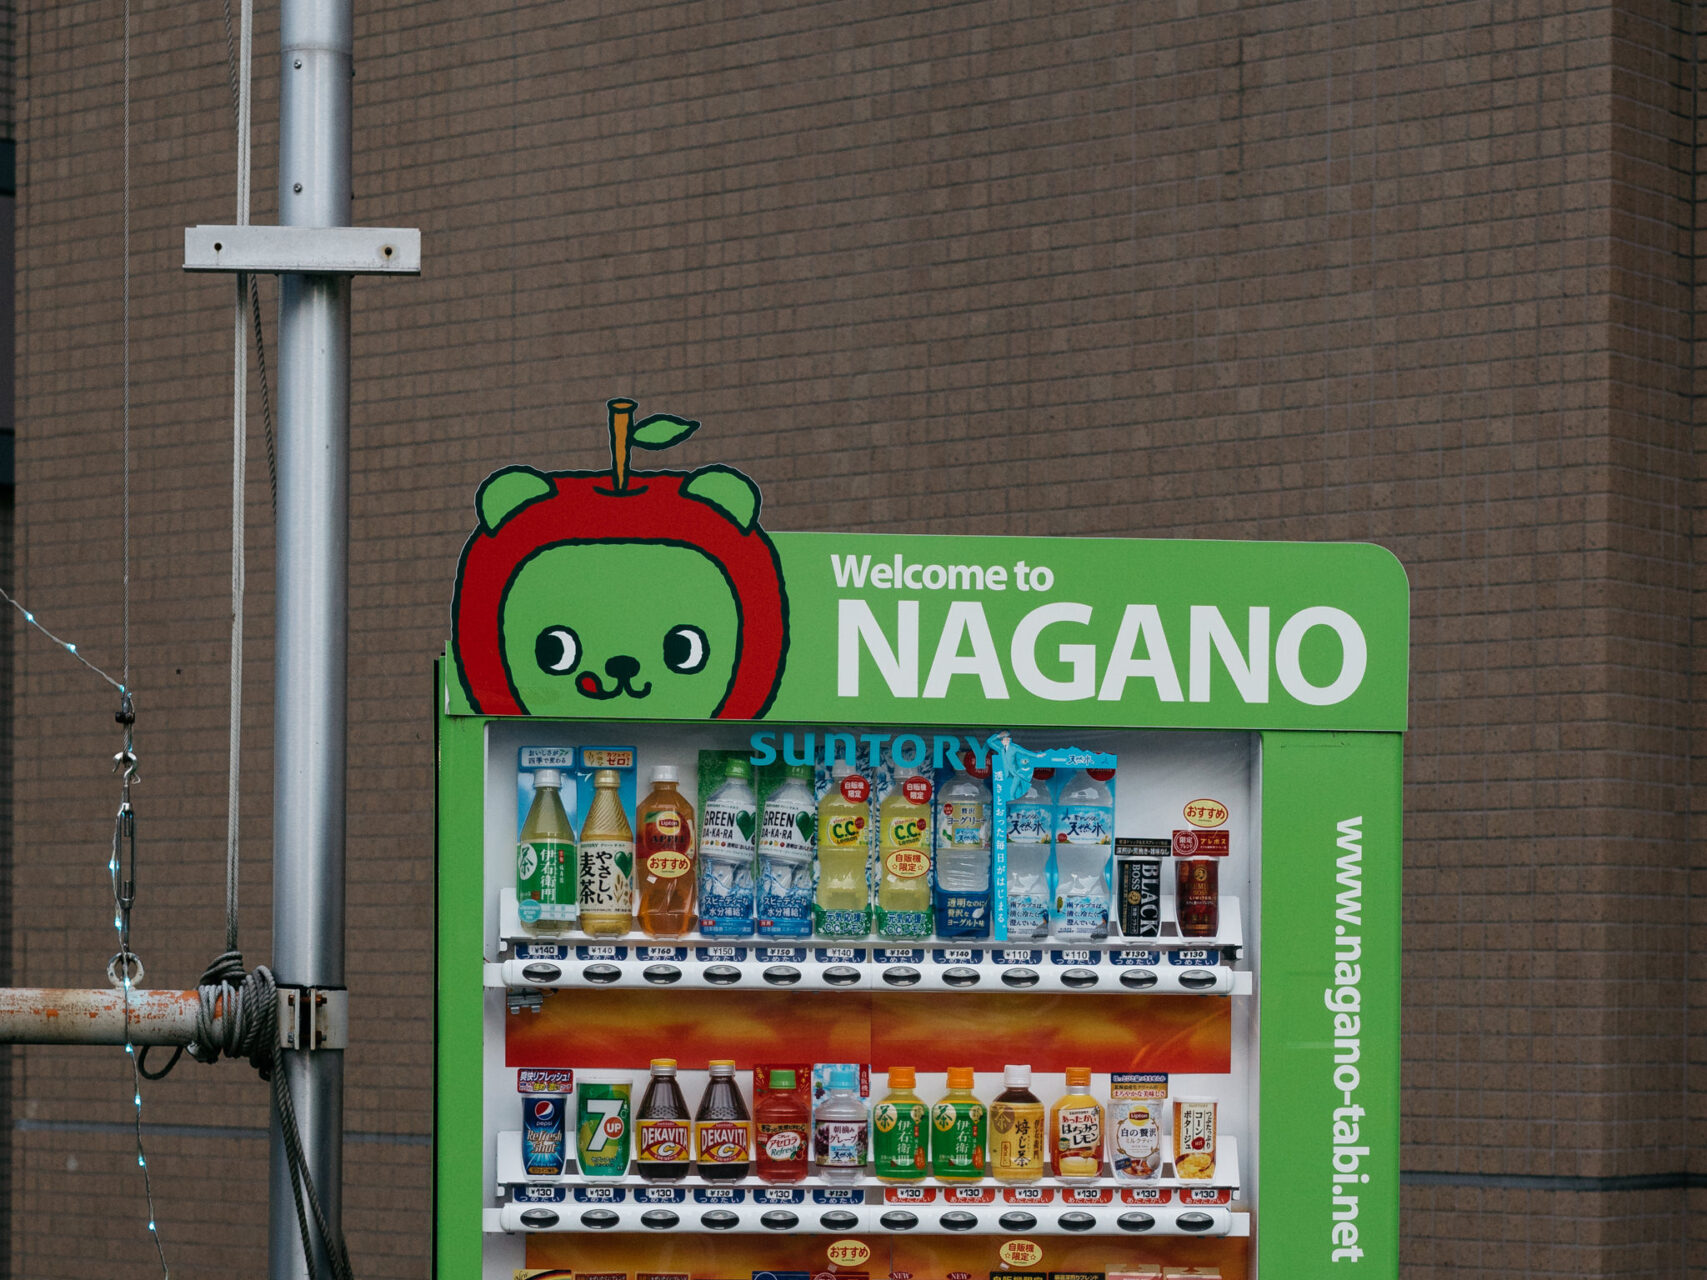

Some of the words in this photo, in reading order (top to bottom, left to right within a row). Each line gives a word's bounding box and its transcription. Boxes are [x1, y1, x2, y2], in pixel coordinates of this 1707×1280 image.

[831, 554, 1008, 591] Welcome
[1014, 561, 1054, 592] to
[837, 599, 1367, 706] NAGANO
[750, 731, 992, 770] SUNTORY
[844, 781, 865, 790] 自販機
[906, 782, 927, 791] 自販機
[847, 790, 862, 799] 限定
[910, 791, 924, 800] 限定
[1187, 805, 1226, 820] おすすめ
[660, 819, 678, 827] Lipton
[704, 810, 735, 827] GREEN
[763, 810, 795, 828] GREEN
[1008, 820, 1047, 836] 天然水
[1067, 821, 1106, 837] 天然水
[1179, 836, 1193, 844] 限定
[993, 770, 1007, 930] 透きとおった毎日がはじまる。
[649, 857, 689, 869] おすすめ
[895, 853, 922, 863] 自販機
[899, 863, 917, 872] 限定
[540, 849, 556, 901] 伊右衛門
[580, 852, 596, 904] 麦茶
[595, 851, 613, 904] やさしい
[1131, 863, 1141, 890] BOSS
[947, 897, 986, 908] 透明なのに
[1140, 863, 1159, 938] BLACK
[947, 919, 985, 928] ヨーグルト味
[535, 946, 555, 954] ¥140
[591, 946, 613, 954] ¥140
[651, 947, 672, 955] ¥160
[713, 947, 733, 955] ¥150
[831, 949, 851, 957] ¥140
[1006, 951, 1028, 959] ¥110
[1065, 951, 1088, 959] ¥110
[1324, 815, 1370, 1262] www.nagano-tabi.net
[520, 1071, 570, 1082] 爽快リフレッシュ!
[876, 1105, 893, 1129] 茶
[934, 1105, 952, 1129] 茶
[1062, 1114, 1097, 1124] あったかい
[586, 1100, 625, 1151] 7
[606, 1123, 621, 1132] UP
[834, 1124, 855, 1133] 朝摘み
[1061, 1123, 1099, 1135] はちみつ
[1195, 1112, 1203, 1136] コーン
[527, 1129, 562, 1142] Refresh
[1120, 1128, 1157, 1138] 白の贅沢
[1184, 1110, 1192, 1150] ポタージュ
[642, 1126, 688, 1150] DEKAVITA
[701, 1127, 747, 1152] DEKAVITA
[769, 1136, 798, 1150] アセロラ
[829, 1134, 858, 1144] グレープ
[897, 1120, 910, 1166] 伊右衛門
[955, 1120, 969, 1166] 伊右衛門
[1073, 1132, 1099, 1146] レモン
[532, 1142, 557, 1153] Shot
[657, 1141, 676, 1157] C
[1014, 1120, 1031, 1168] 焙じ茶
[717, 1142, 735, 1158] C
[771, 1145, 799, 1156] Refresh
[530, 1188, 552, 1197] ¥130
[590, 1188, 611, 1197] ¥130
[651, 1189, 672, 1197] ¥130
[769, 1190, 790, 1198] ¥130
[900, 1189, 921, 1197] ¥130
[959, 1189, 980, 1197] ¥130
[1018, 1190, 1039, 1198] ¥130
[1077, 1190, 1098, 1198] ¥130
[1136, 1190, 1157, 1198] ¥130
[829, 1246, 869, 1259] おすすめ
[1008, 1243, 1035, 1252] 自販機
[1011, 1252, 1030, 1261] 限定
